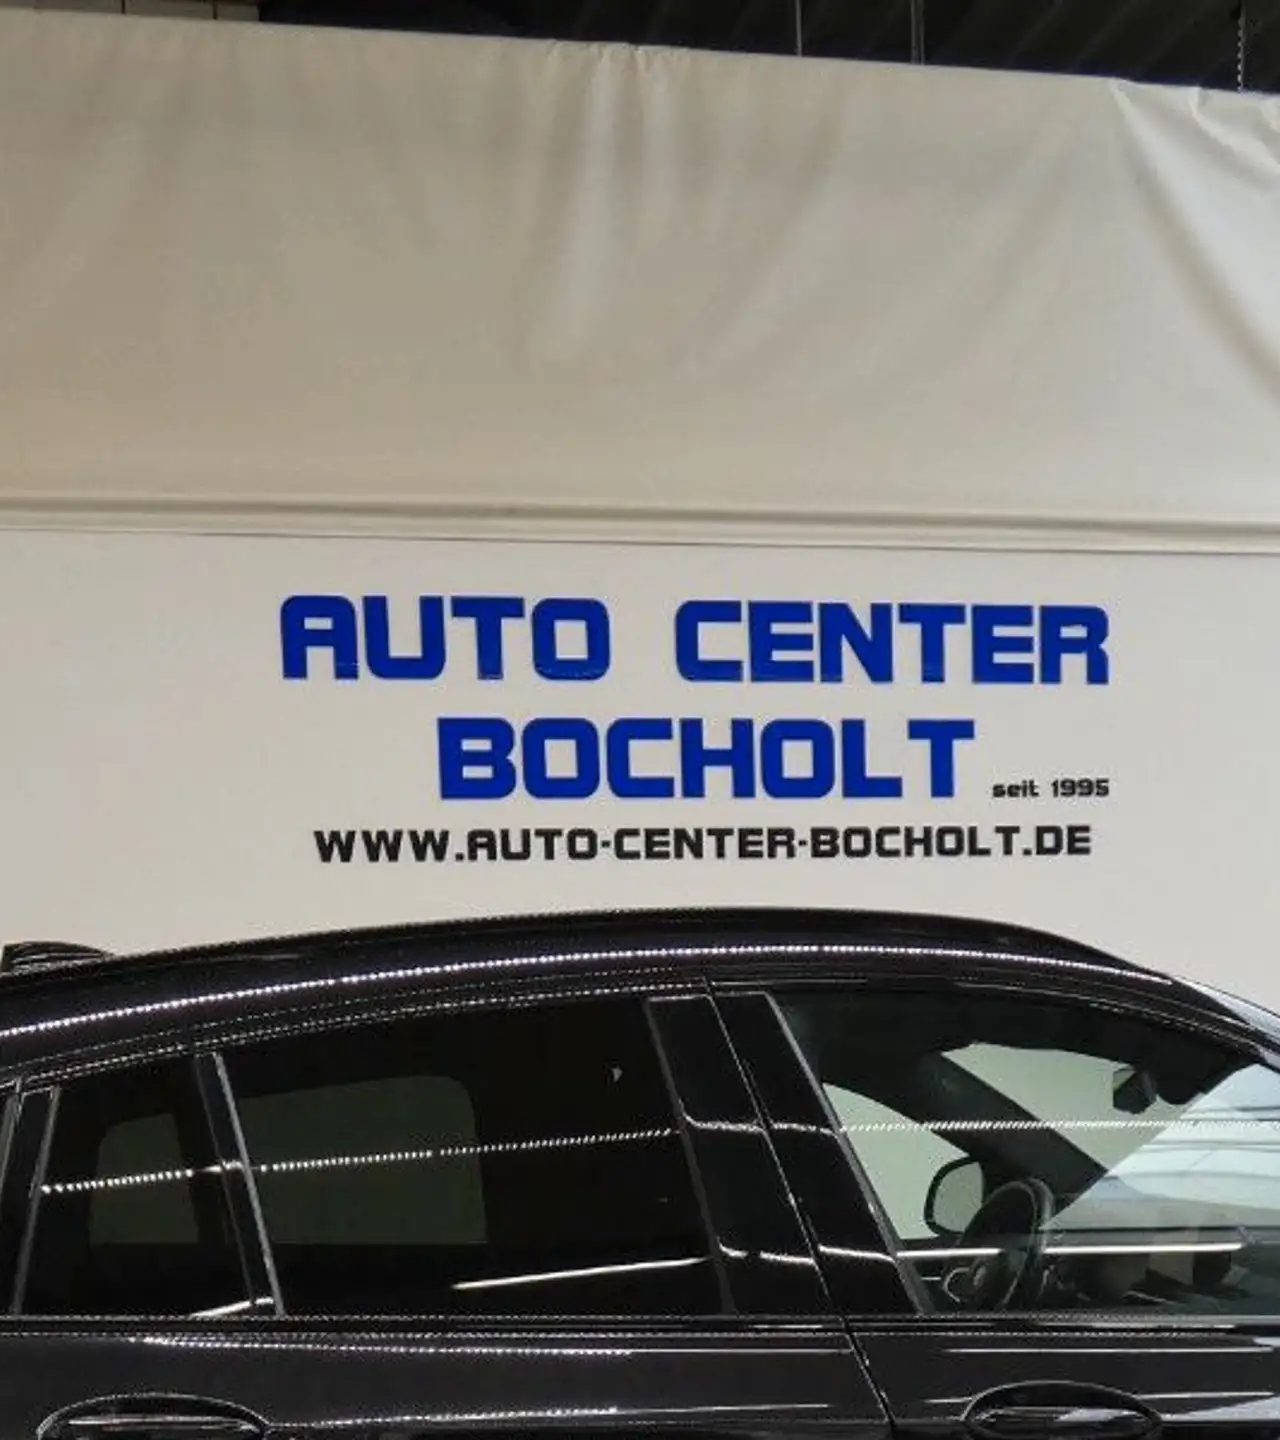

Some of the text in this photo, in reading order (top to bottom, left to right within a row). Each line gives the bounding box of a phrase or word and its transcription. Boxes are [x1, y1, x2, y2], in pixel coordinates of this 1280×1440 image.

[280, 594, 1112, 687] AUTO CENTER
[437, 715, 1111, 801] BOCHOLT seit 1995
[313, 825, 1092, 863] WWW.AUTO-CENTER-BOCHOLT.DE
